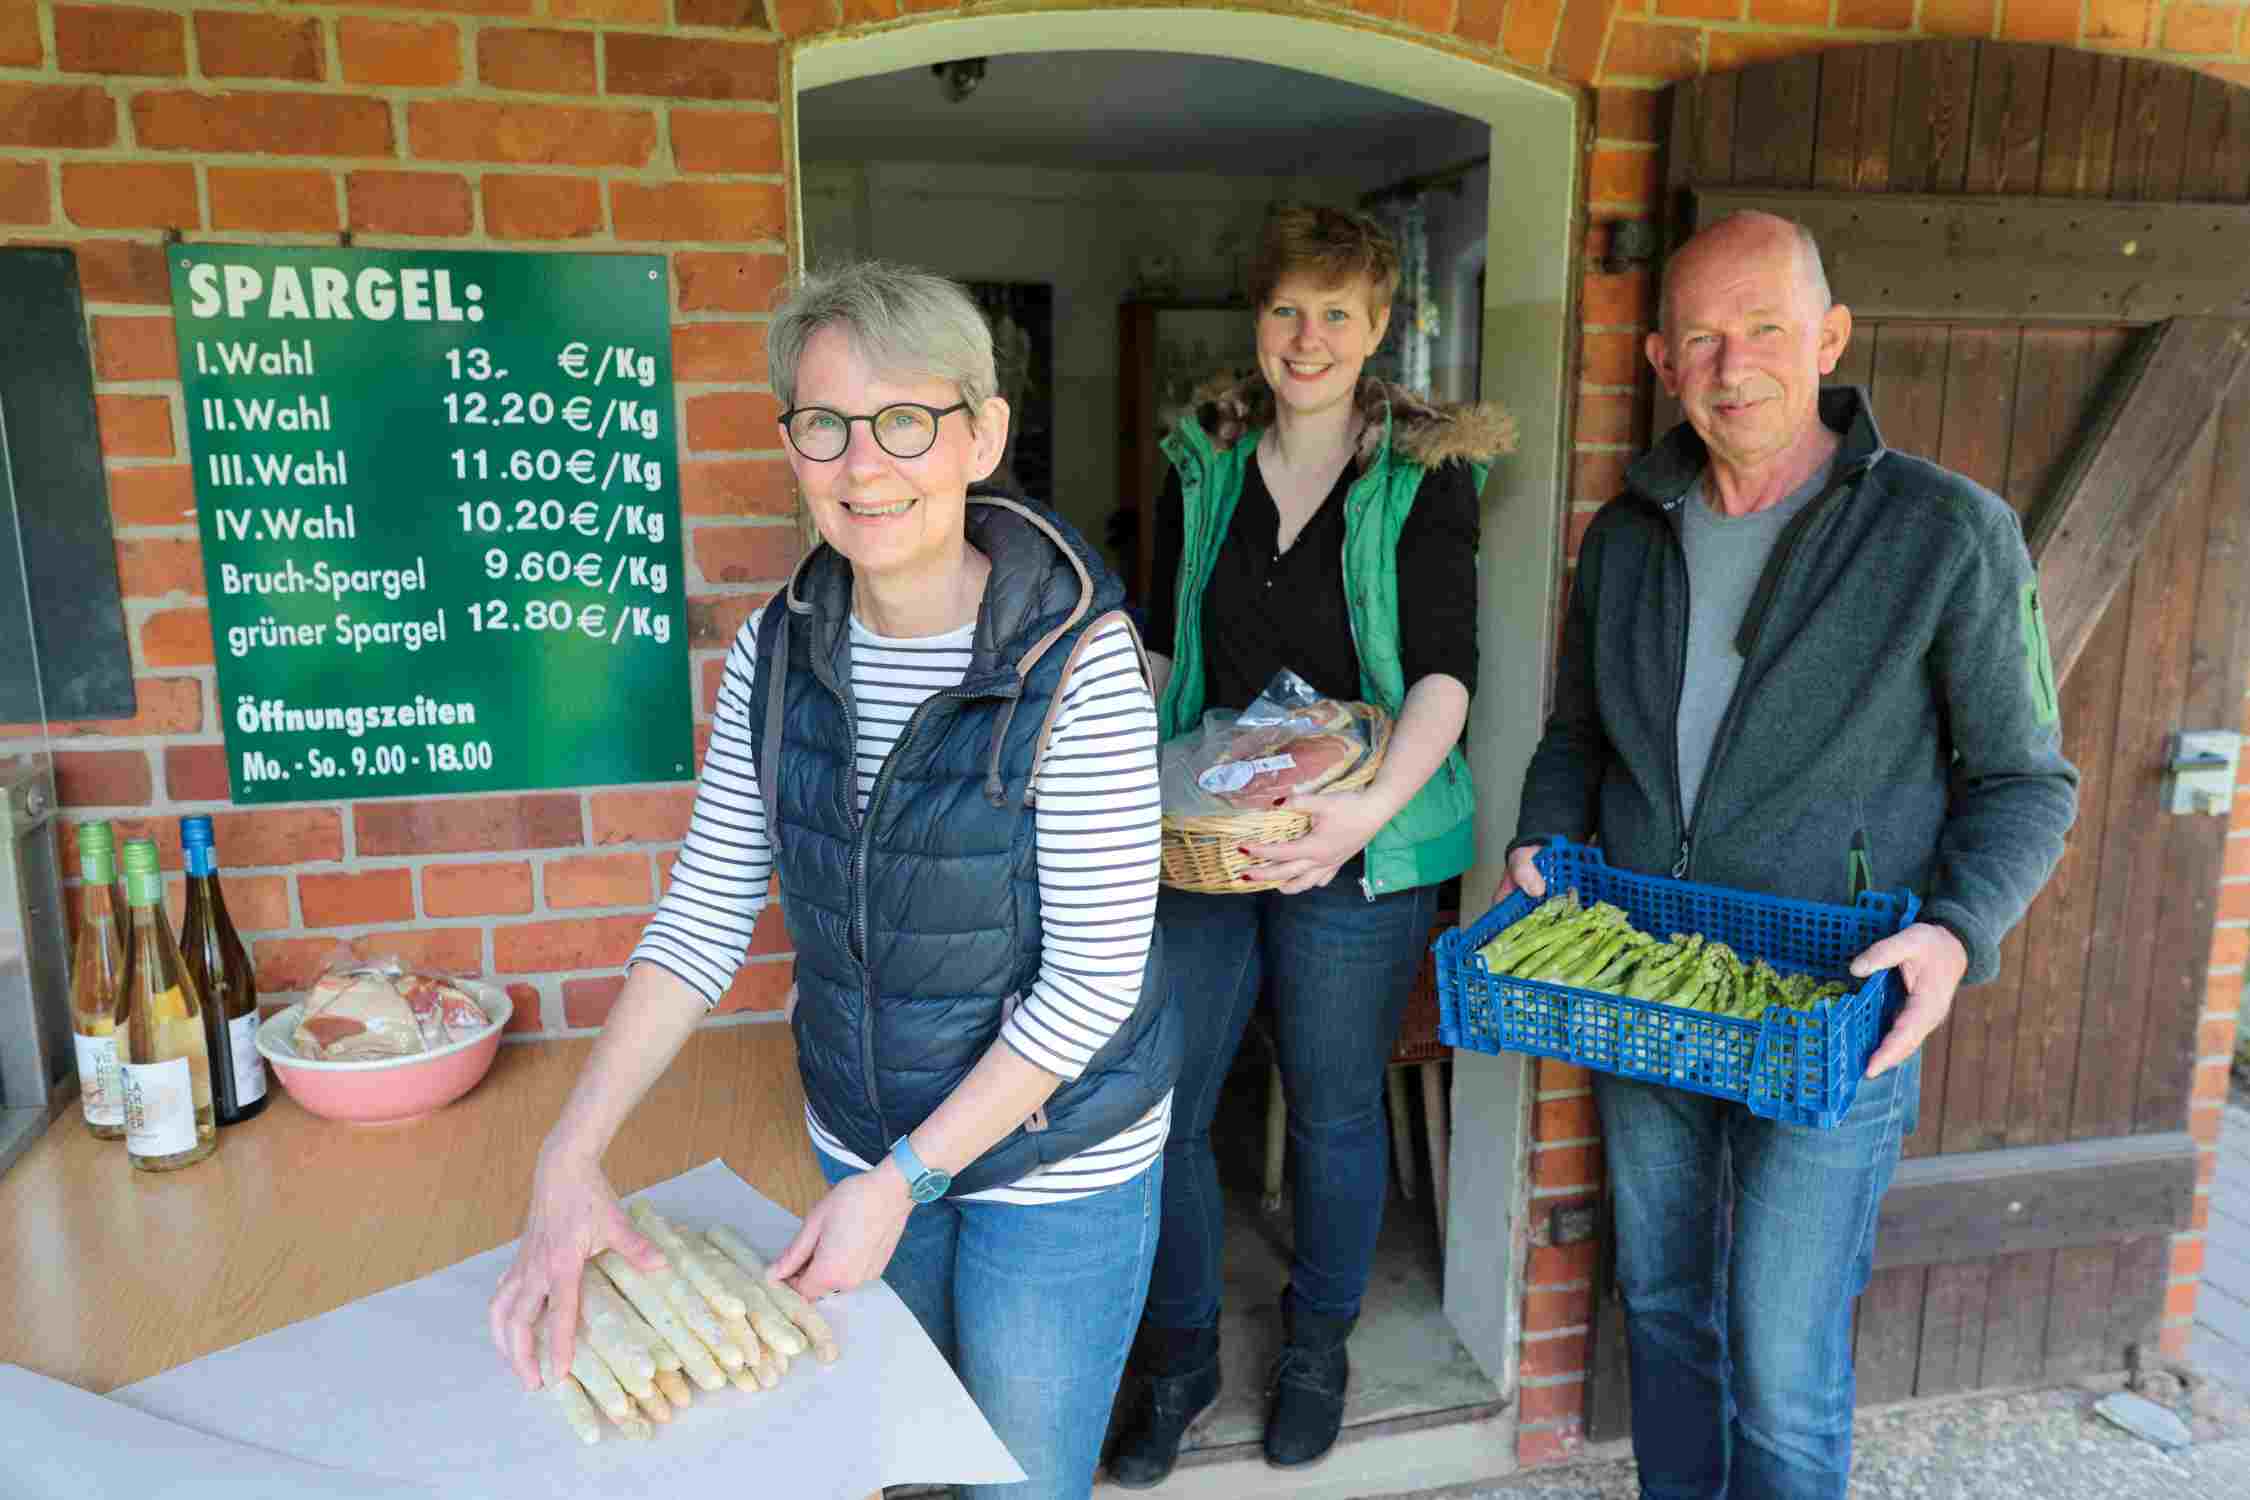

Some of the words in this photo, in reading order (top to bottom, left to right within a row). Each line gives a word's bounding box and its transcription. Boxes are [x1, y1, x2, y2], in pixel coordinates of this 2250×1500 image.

[188, 263, 484, 322] SPARGEL:
[197, 339, 313, 375] I.Wahl
[202, 395, 330, 431] II.Wahl
[209, 450, 347, 486] III.Wahl
[215, 504, 355, 541] IV.Wahl
[221, 557, 426, 601] Bruch-Spargel
[228, 616, 327, 657] grüner
[335, 608, 446, 653] Spargel
[236, 695, 475, 737] Öffnungszeiten
[351, 745, 406, 776] 9.00
[426, 741, 493, 772] 18.00
